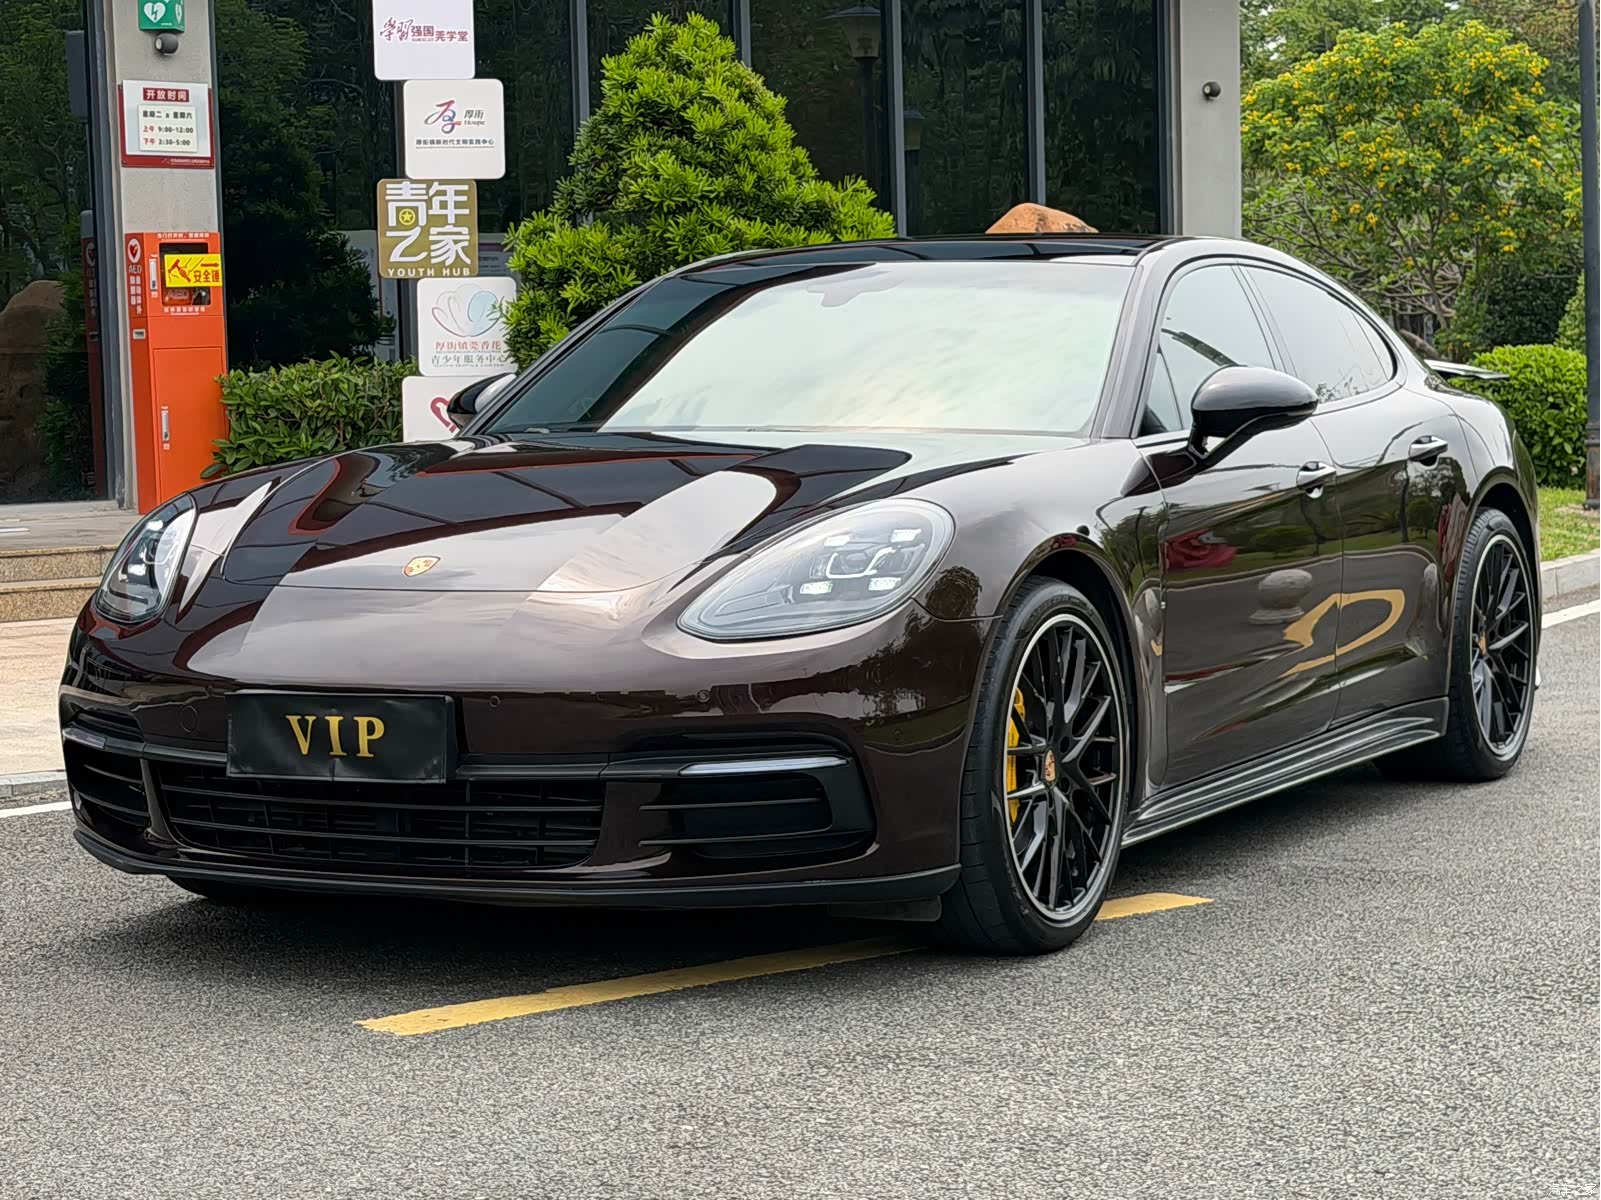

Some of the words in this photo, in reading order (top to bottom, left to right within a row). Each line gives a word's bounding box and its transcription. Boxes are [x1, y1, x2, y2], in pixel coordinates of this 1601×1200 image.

[146, 89, 187, 101] 开放时间
[143, 110, 163, 118] 星期二
[173, 111, 193, 119] 星期六
[143, 125, 155, 133] 上午
[158, 126, 194, 134] 9:00-12:00
[385, 181, 470, 227] 青年
[386, 225, 472, 266] 之家
[387, 267, 435, 277] YOUTH
[442, 267, 471, 276] HUB
[285, 715, 385, 757] VIP
